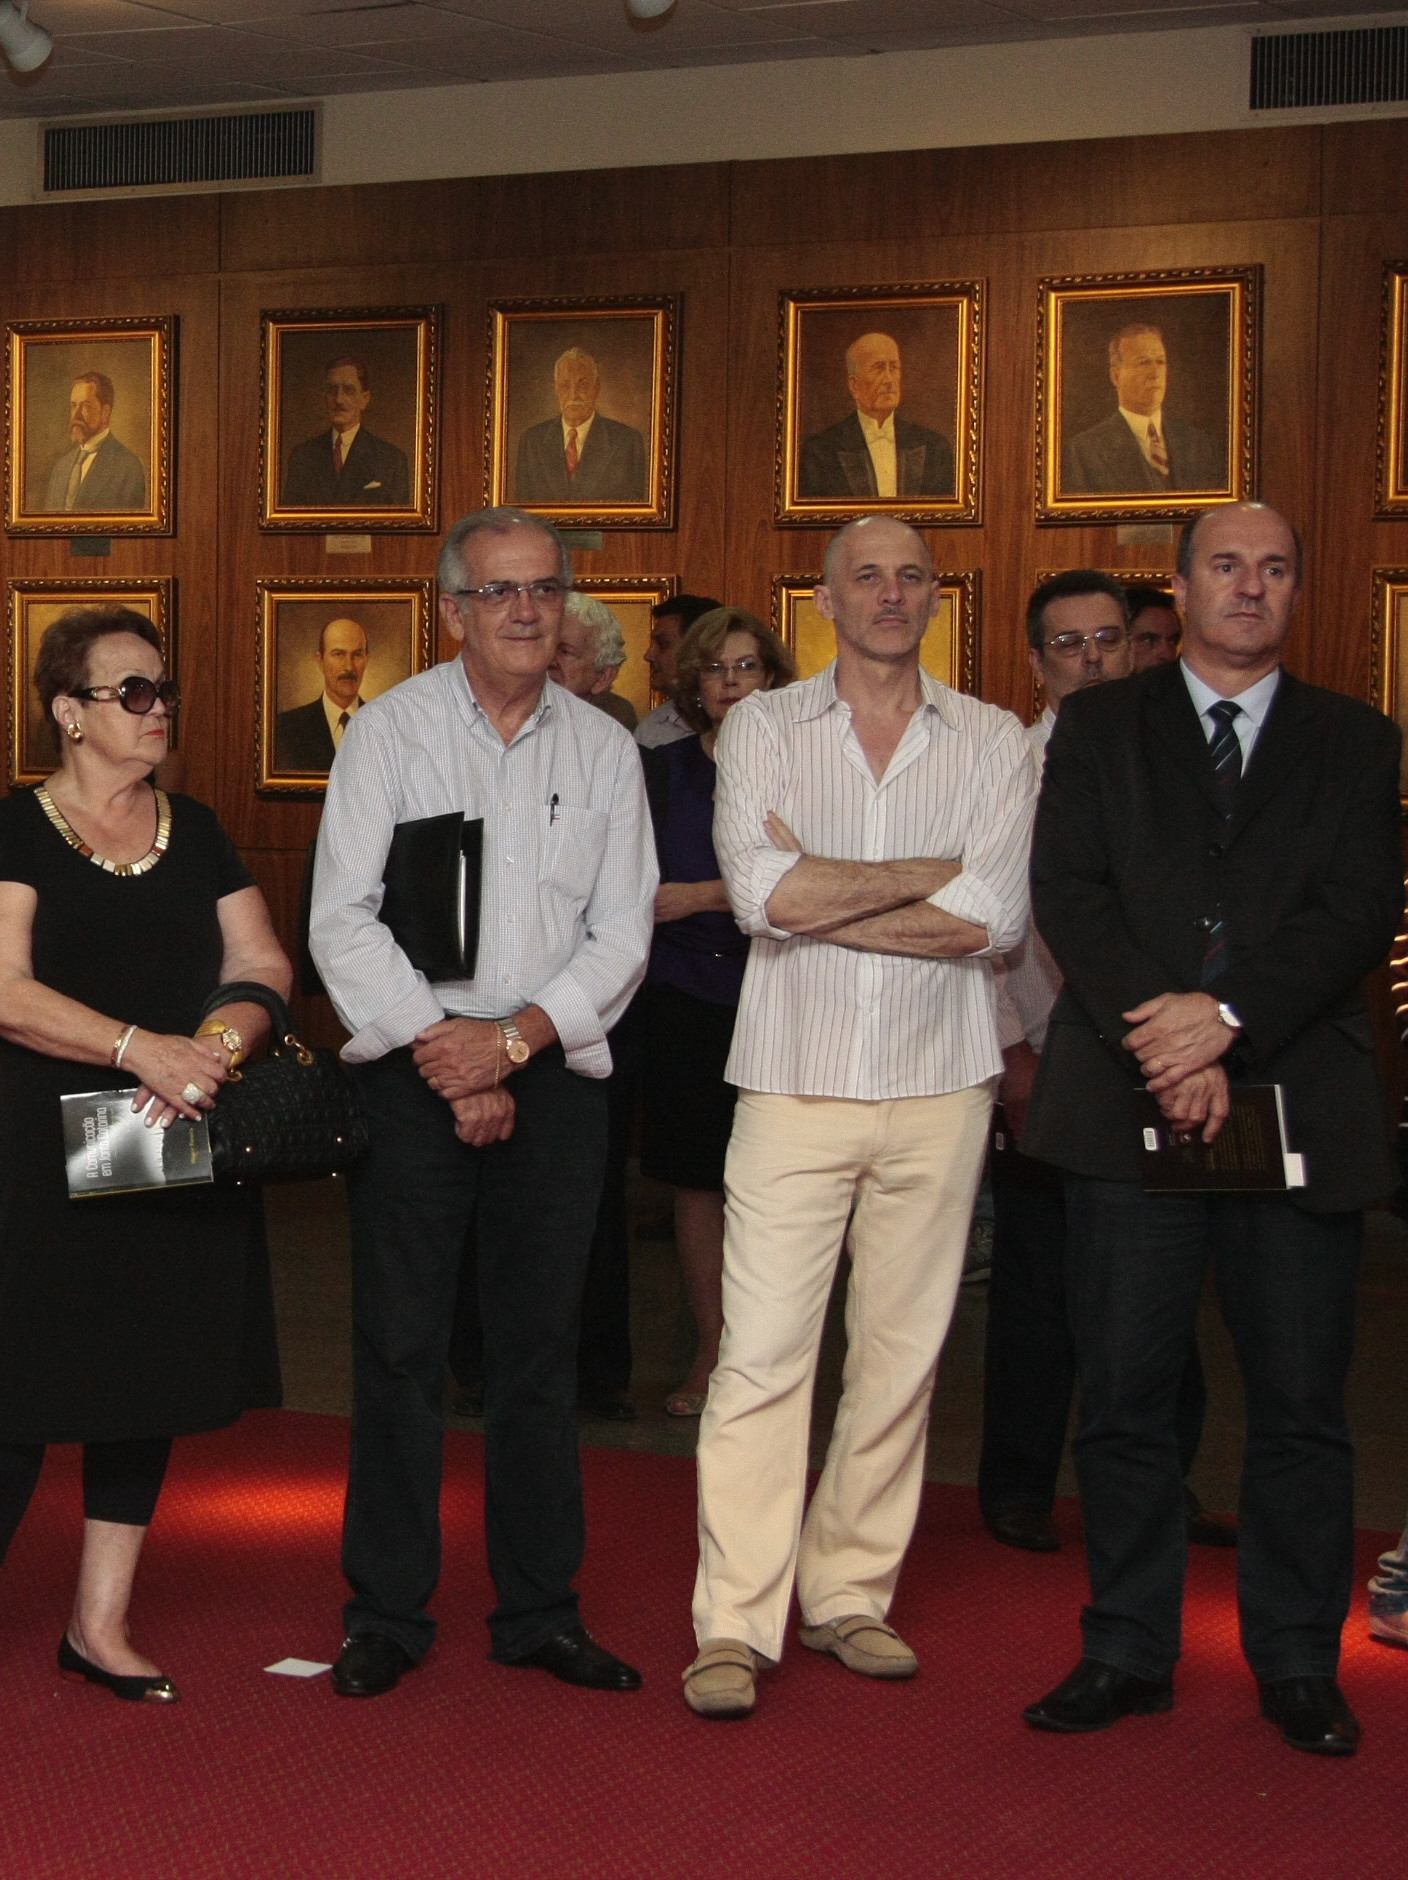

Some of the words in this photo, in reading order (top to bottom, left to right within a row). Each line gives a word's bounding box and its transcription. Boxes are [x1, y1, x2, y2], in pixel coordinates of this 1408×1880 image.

[95, 1107, 109, 1140] Catarina
[83, 1117, 98, 1171] Comunicação
[102, 1163, 113, 1177] em
